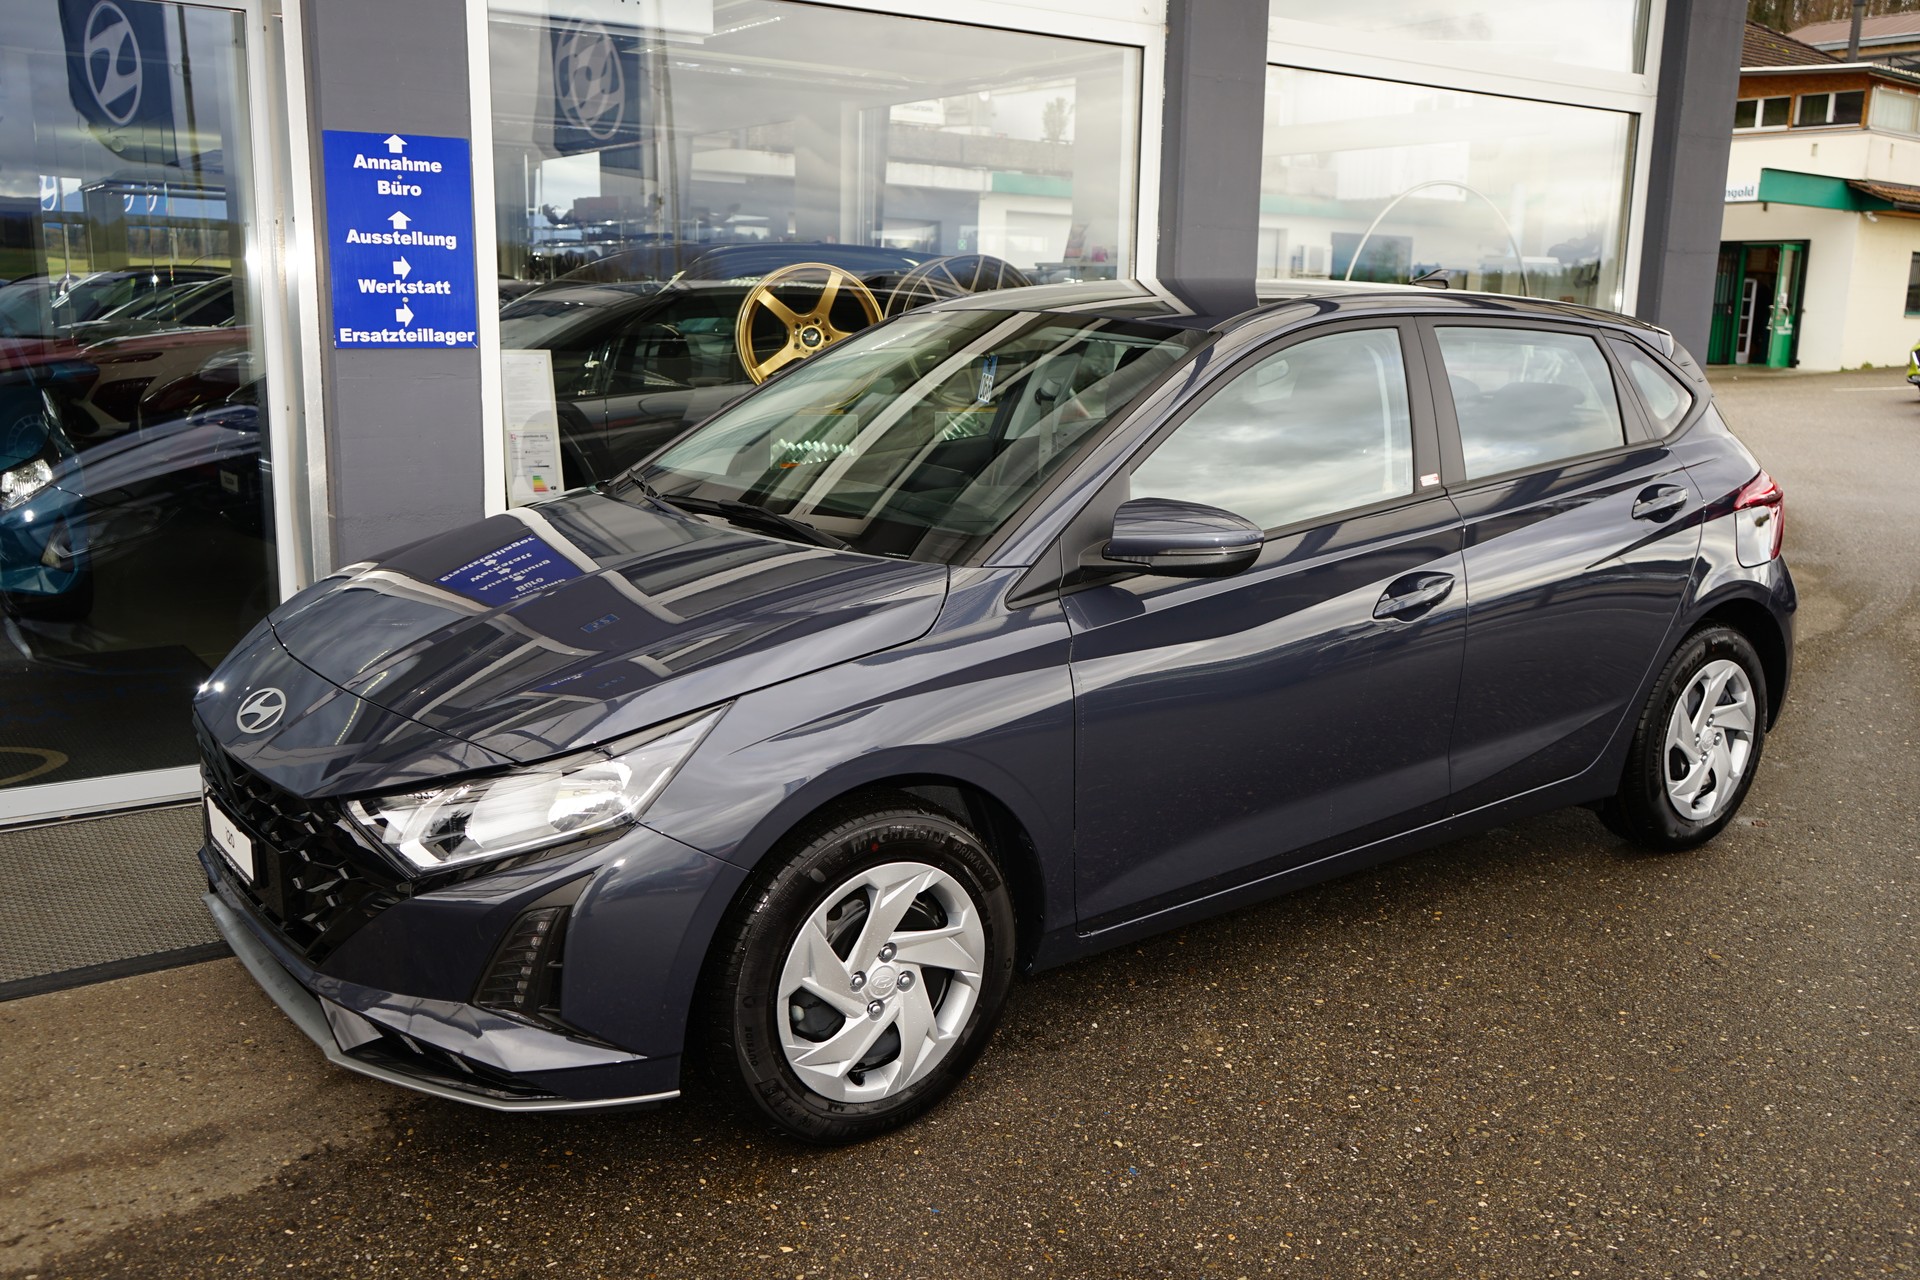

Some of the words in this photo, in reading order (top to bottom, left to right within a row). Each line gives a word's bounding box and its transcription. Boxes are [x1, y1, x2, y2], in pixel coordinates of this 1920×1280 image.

[353, 154, 442, 173] Annahme
[377, 180, 422, 196] Büro
[346, 229, 456, 249] Ausstellung
[357, 279, 451, 294] Werkstatt
[339, 328, 475, 345] Ersatzteillager
[953, 844, 991, 879] PRIMACY
[744, 1026, 759, 1067] OUTSIDE
